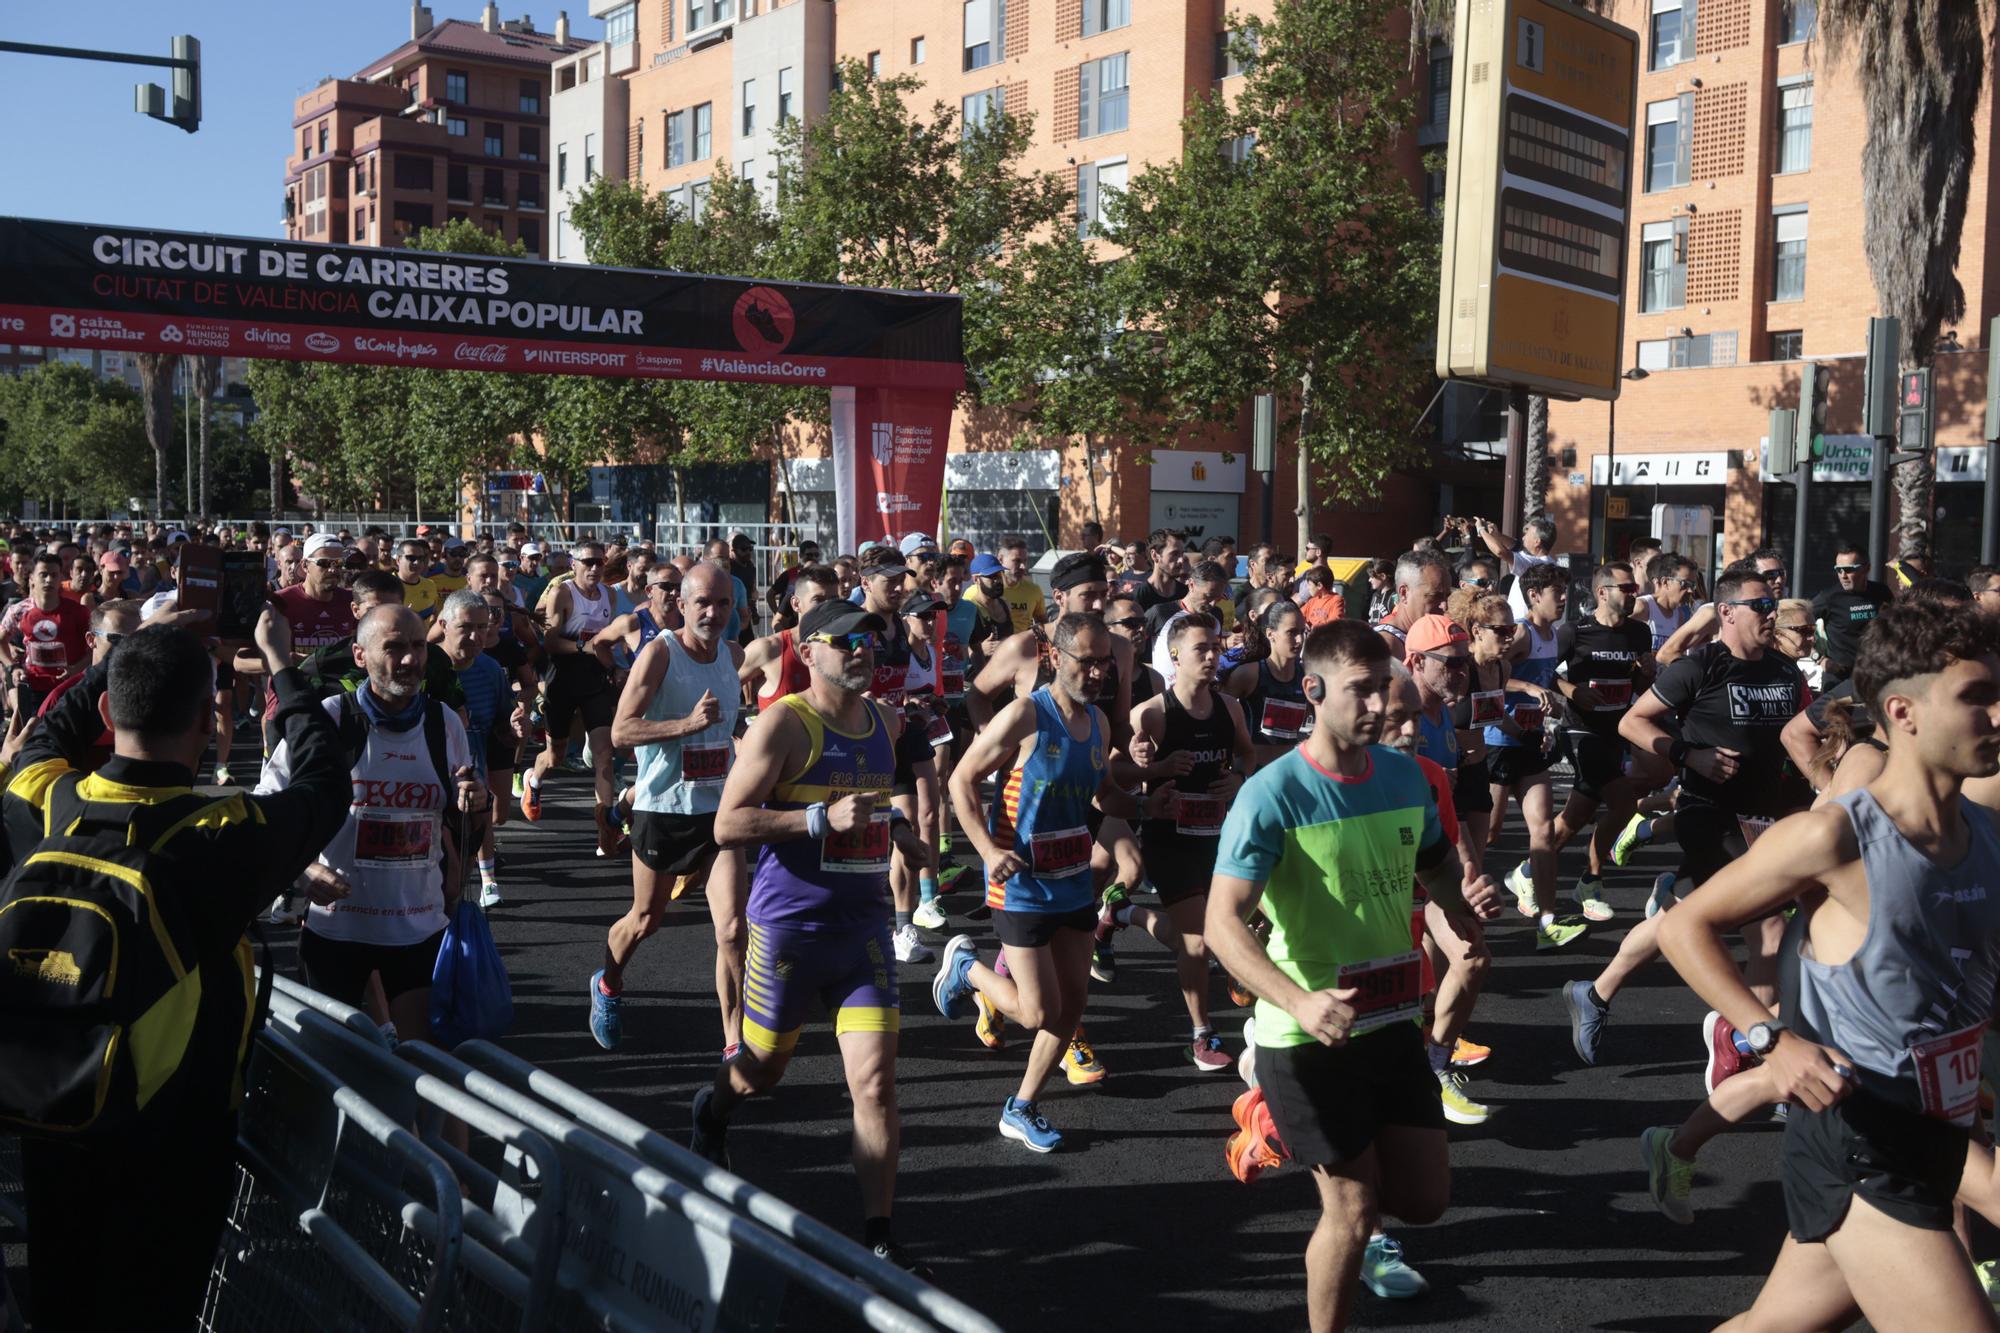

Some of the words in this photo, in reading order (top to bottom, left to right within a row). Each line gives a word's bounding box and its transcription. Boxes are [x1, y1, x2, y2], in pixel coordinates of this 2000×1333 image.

[92, 234, 248, 274] CIRCUIT
[259, 249, 309, 279] DE
[316, 253, 510, 295] CARRERES
[92, 273, 187, 301] CIUTAT
[194, 280, 228, 305] DE
[235, 283, 360, 313] VALÈNCIA
[367, 290, 484, 325] CAIXA
[487, 299, 645, 335] POPULAR
[0, 316, 25, 332] re
[80, 316, 122, 329] caixa
[80, 327, 146, 342] popular
[186, 329, 230, 341] TRINIDAD
[244, 328, 292, 345] divina
[186, 338, 230, 349] ALFONSO
[354, 336, 369, 350] El
[367, 338, 397, 352] Corte
[395, 336, 437, 359] Inglés
[538, 349, 627, 366] INTERSPORT
[645, 355, 683, 370] aspaym
[699, 356, 826, 377] #ValènciaCorre
[1825, 445, 1873, 459] Urban
[1813, 459, 1870, 476] unning
[1591, 650, 1638, 662] REDOLAT
[1732, 685, 1793, 716] SAMAINST
[1761, 702, 1778, 716] VAL
[1194, 748, 1227, 763] DOLAT
[830, 771, 853, 787] ELS
[340, 903, 379, 916] esencia
[381, 908, 395, 917] en
[1949, 1047, 1979, 1085] 10
[630, 1260, 705, 1333] RUNNING
